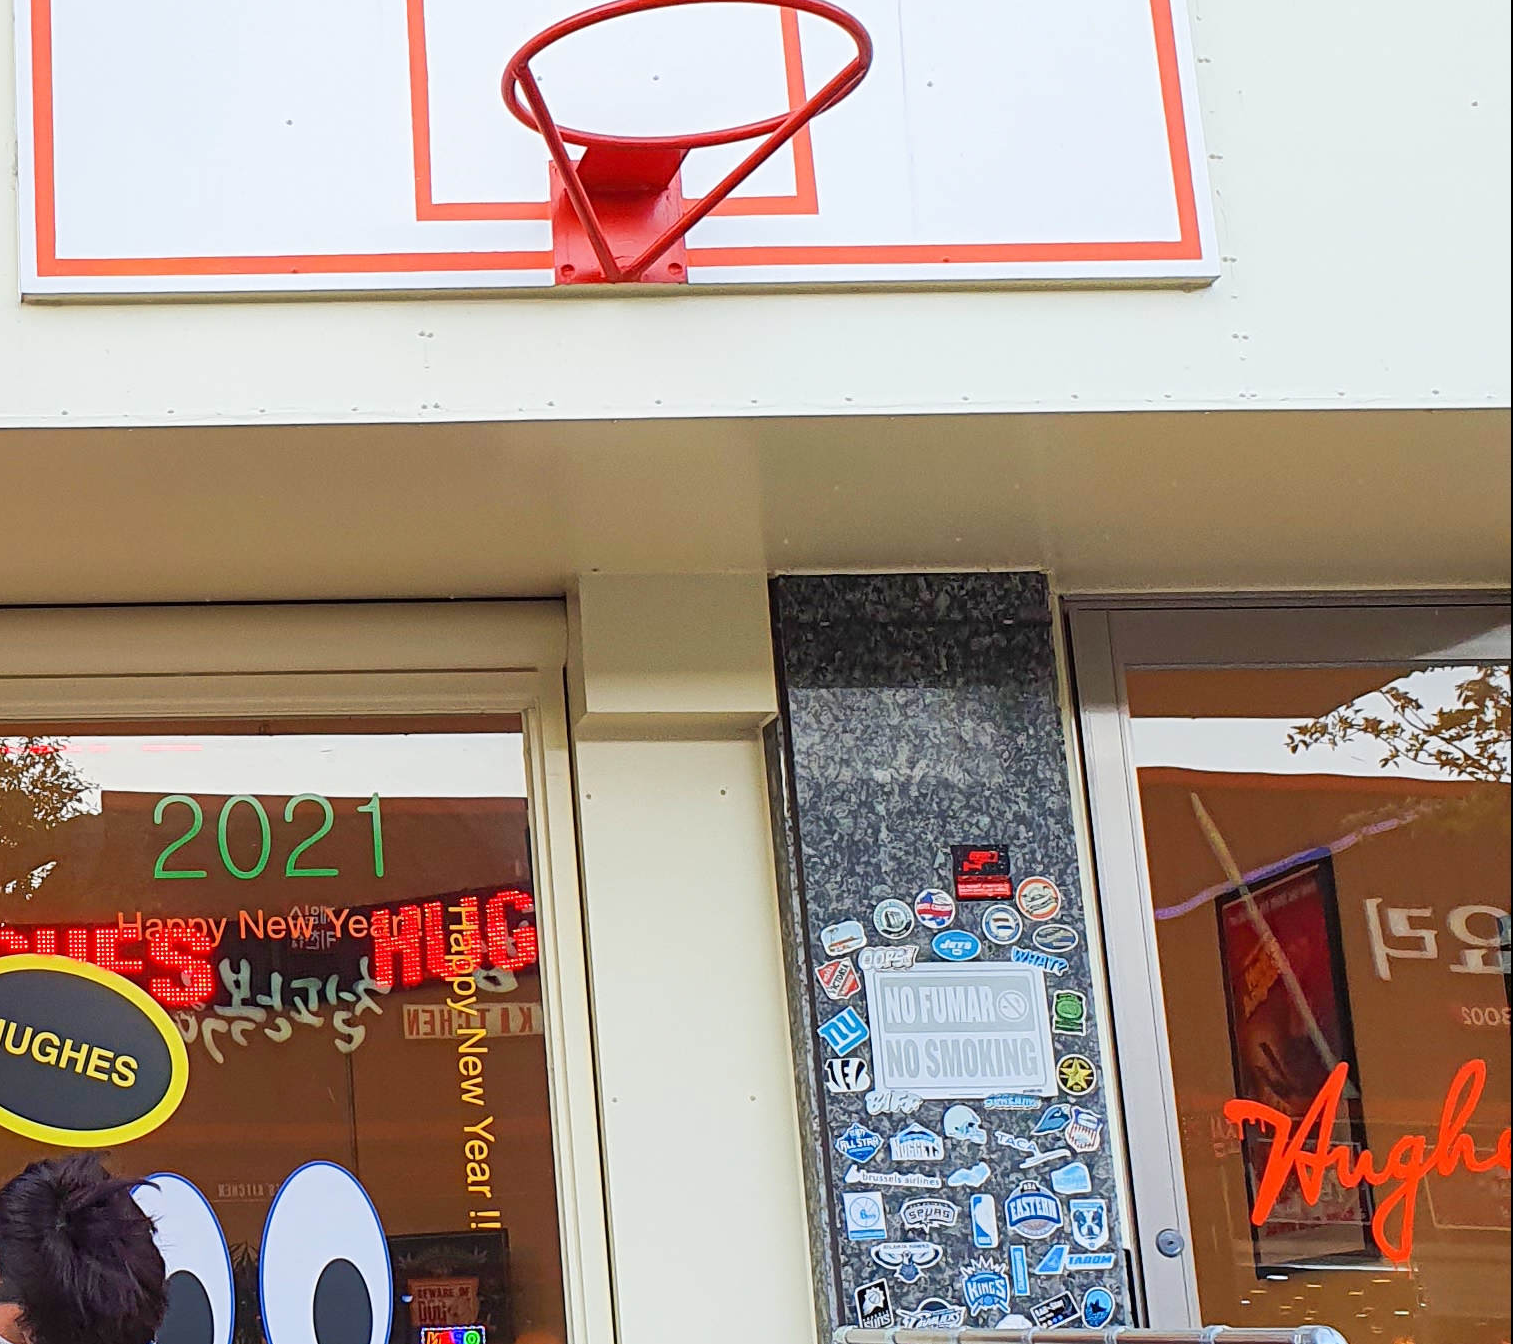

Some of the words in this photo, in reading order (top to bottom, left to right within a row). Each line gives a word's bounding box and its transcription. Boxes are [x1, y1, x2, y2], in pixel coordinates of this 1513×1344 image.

[152, 791, 387, 880] 2021
[239, 909, 316, 940] New
[447, 906, 478, 1016] Happy
[1012, 947, 1068, 974] WHAT?
[884, 985, 916, 1025] NO
[918, 984, 996, 1024] FUMAR
[456, 1028, 489, 1106] New
[886, 1038, 920, 1079] NO
[924, 1037, 1039, 1079] SMOKING
[463, 1115, 497, 1198] Year
[998, 1134, 1037, 1153] TACA
[862, 1173, 902, 1184] brussels
[904, 1175, 940, 1187] airlines
[1008, 1196, 1060, 1223] EASTERN
[967, 1279, 1008, 1301] KINGS
